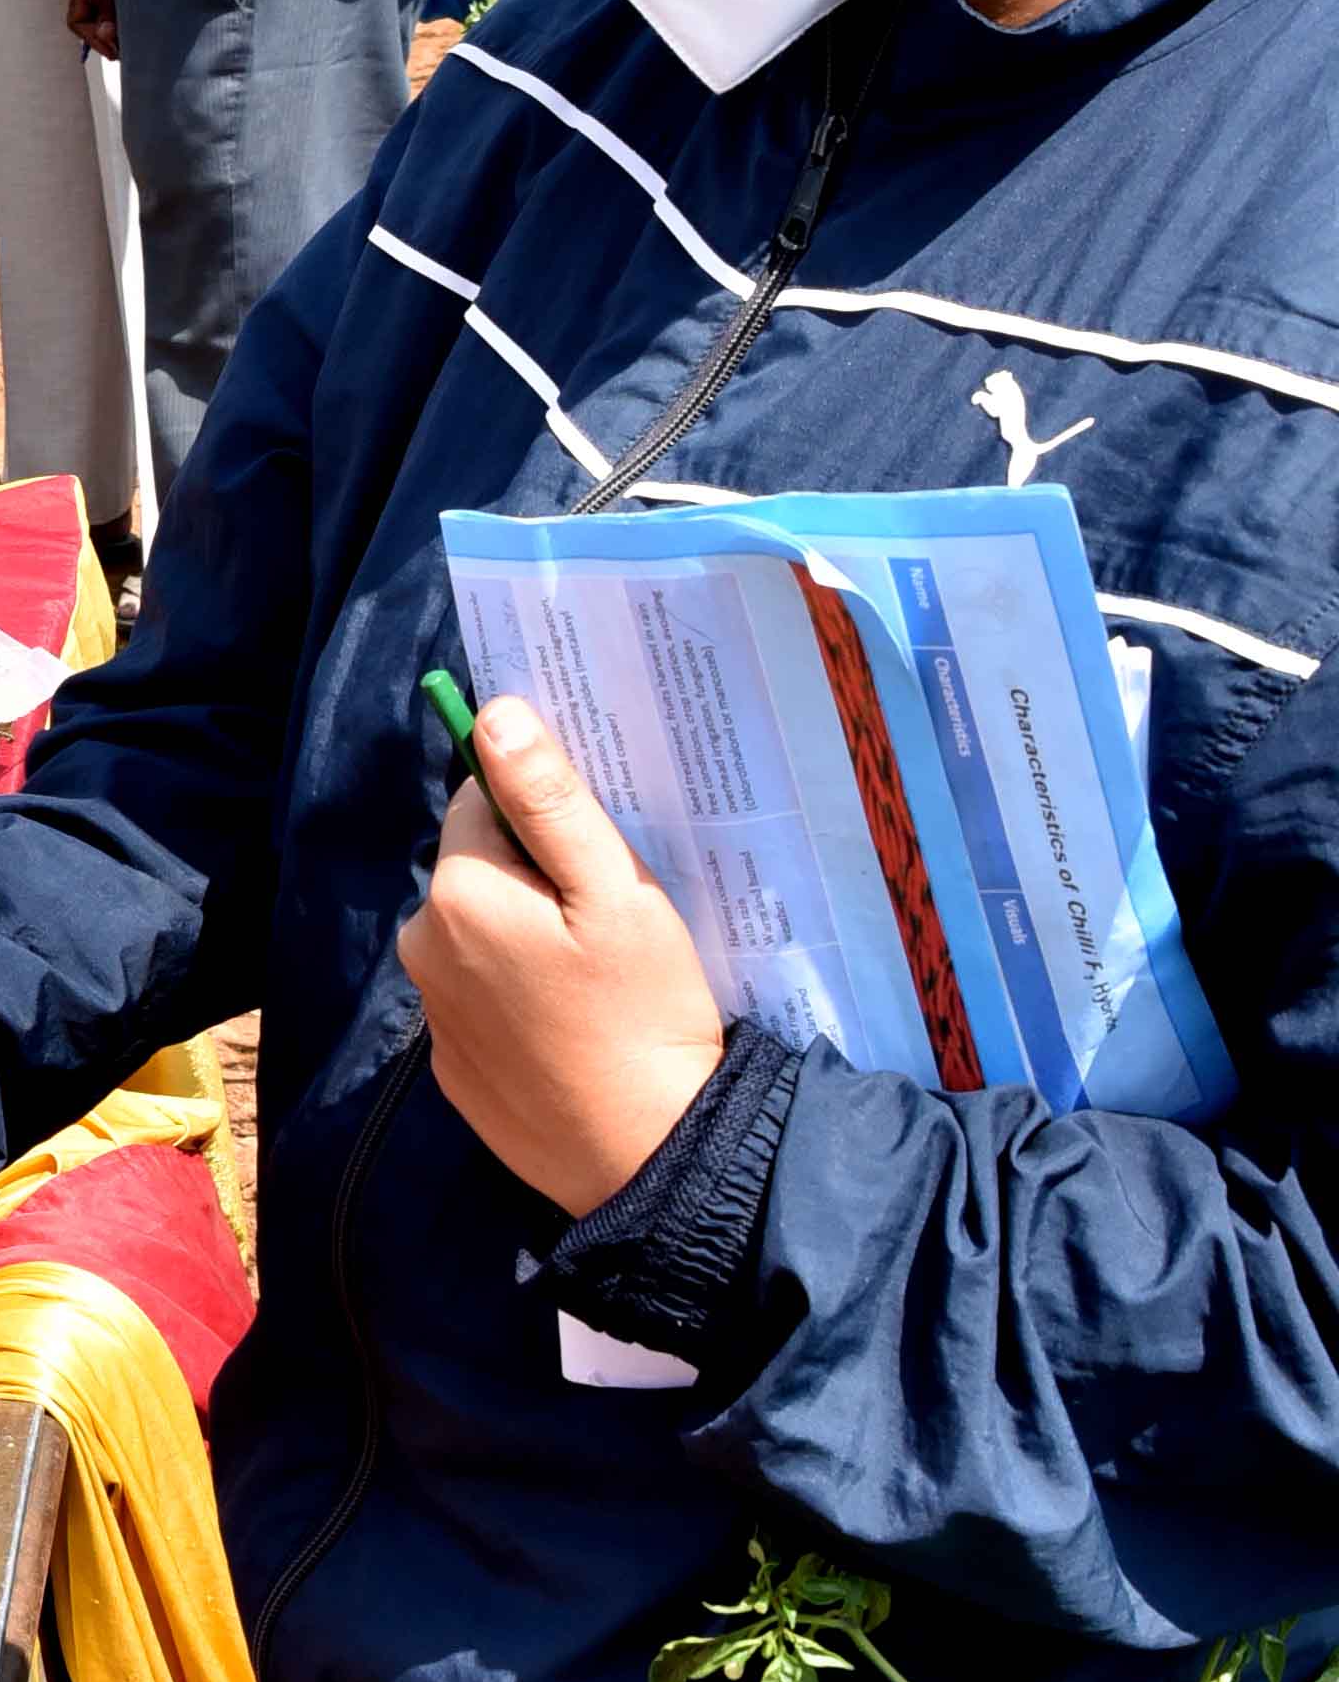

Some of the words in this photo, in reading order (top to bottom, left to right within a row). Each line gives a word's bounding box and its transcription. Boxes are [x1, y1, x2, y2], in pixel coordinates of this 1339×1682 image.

[908, 566, 930, 610] Name
[535, 644, 550, 669] bed
[934, 655, 972, 759] Characteristics
[1010, 688, 1068, 864] Characteristics
[686, 786, 704, 816] Seed
[1059, 868, 1081, 893] of
[1002, 898, 1029, 946] Visuals
[1068, 899, 1098, 956] Chilli
